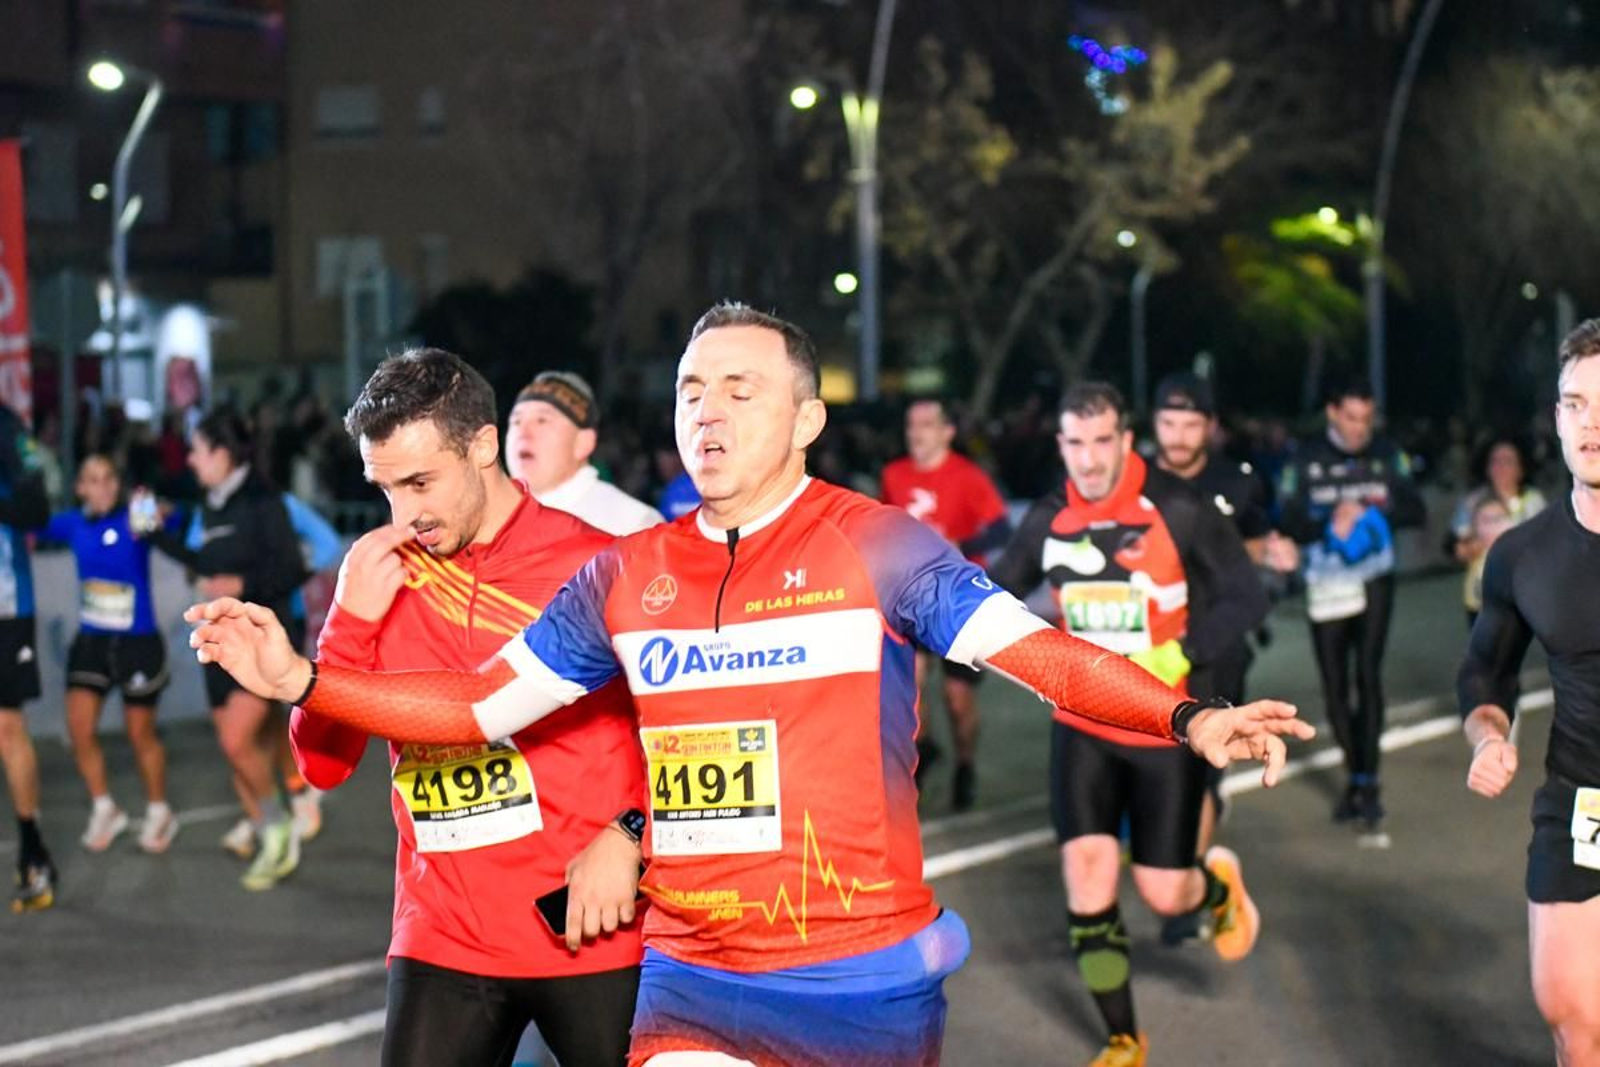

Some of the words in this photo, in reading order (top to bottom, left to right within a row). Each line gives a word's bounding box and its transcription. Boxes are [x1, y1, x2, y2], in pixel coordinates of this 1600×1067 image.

[744, 600, 764, 614] DE
[766, 595, 793, 611] LAS
[796, 587, 846, 606] HERAS
[682, 645, 807, 675] Avanza
[412, 757, 517, 808] 4198
[656, 761, 755, 806] 4191
